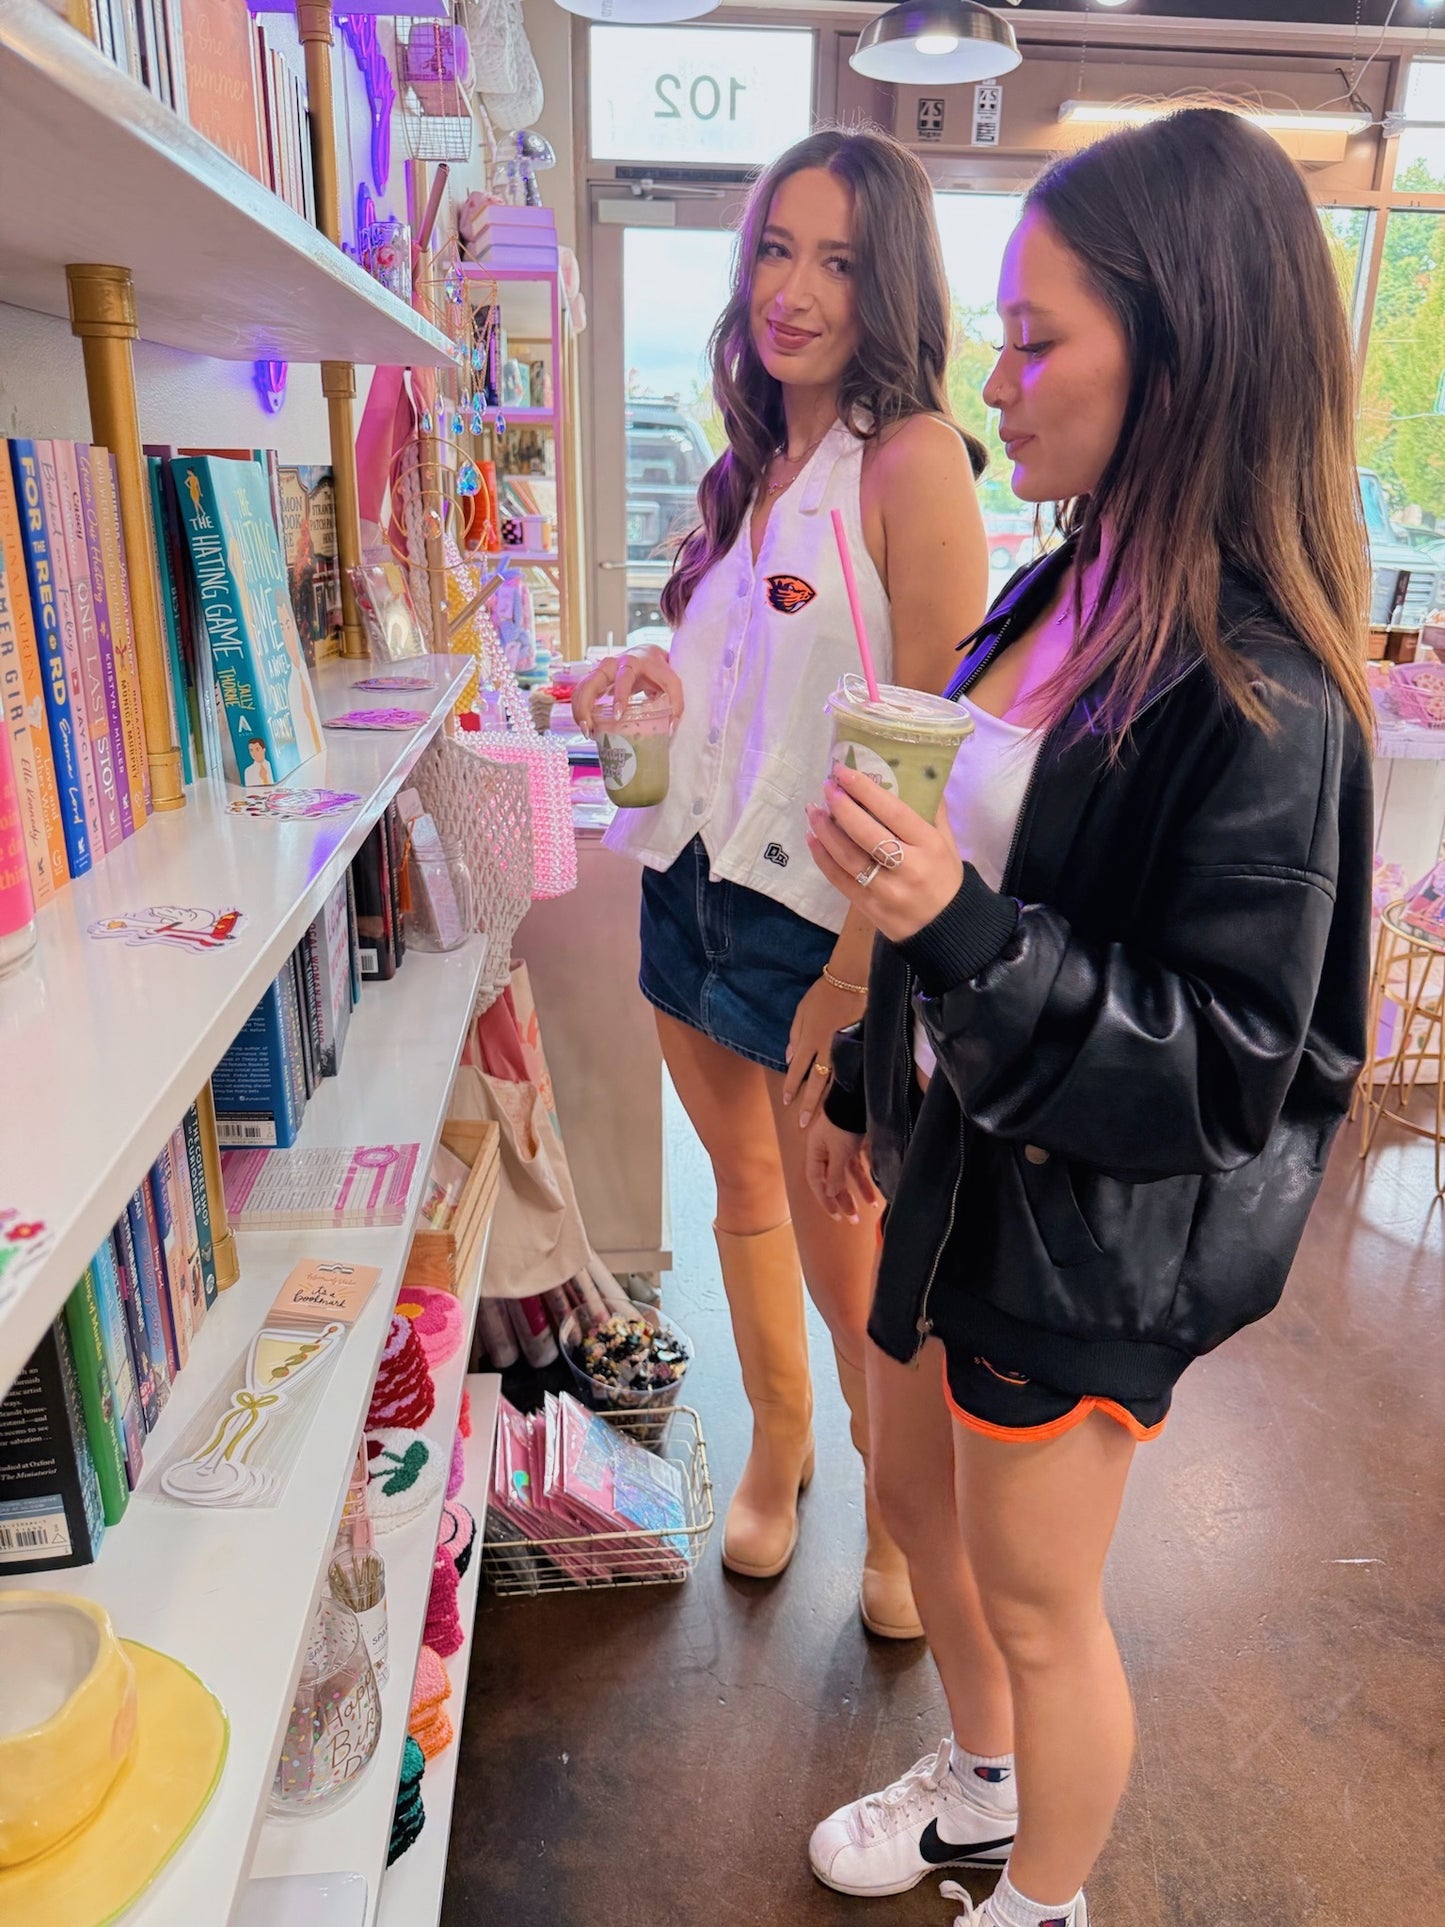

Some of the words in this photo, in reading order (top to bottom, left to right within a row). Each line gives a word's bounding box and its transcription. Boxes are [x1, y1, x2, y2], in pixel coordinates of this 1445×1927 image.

[20, 456, 42, 531] FOR
[41, 462, 62, 538] Booked
[80, 456, 92, 505] Given
[73, 491, 83, 540] Casey
[86, 511, 99, 542] Our
[100, 488, 110, 521] WERE
[105, 528, 115, 568] NEVER
[189, 515, 215, 531] THE
[33, 541, 46, 553] THE
[91, 545, 104, 604] History
[191, 534, 230, 600] HATING
[35, 562, 69, 706] RECORD
[78, 583, 95, 642] ONE
[205, 603, 245, 662] GAME
[4, 669, 27, 742] GIRL
[86, 655, 106, 724] LAST
[106, 653, 117, 709] KRISTYN
[114, 725, 125, 774] MILLER
[217, 665, 239, 709] THORNE
[238, 682, 256, 711] SALLY
[76, 705, 89, 763] JAYCI
[84, 772, 97, 809] LEE
[121, 679, 131, 729] MONICA
[127, 730, 139, 779] MURPHY
[59, 718, 73, 779] Emma
[69, 788, 85, 824] Lord
[97, 737, 116, 801] STOP
[27, 787, 39, 848] Kennedy
[307, 963, 317, 1016] YOUNGER
[311, 955, 321, 995] WOMAN
[316, 1000, 325, 1044] MISSING
[191, 1119, 200, 1144] THE
[187, 1137, 201, 1217] CURIOSITIES
[195, 1145, 205, 1193] COFFEE
[200, 1196, 209, 1227] SHOP
[91, 1315, 103, 1361] Murder
[117, 1291, 127, 1337] THINGS
[23, 1386, 42, 1396] artist
[1, 1472, 15, 1482] The
[15, 1467, 57, 1481] Miniaturist
[29, 1457, 56, 1469] Oxford
